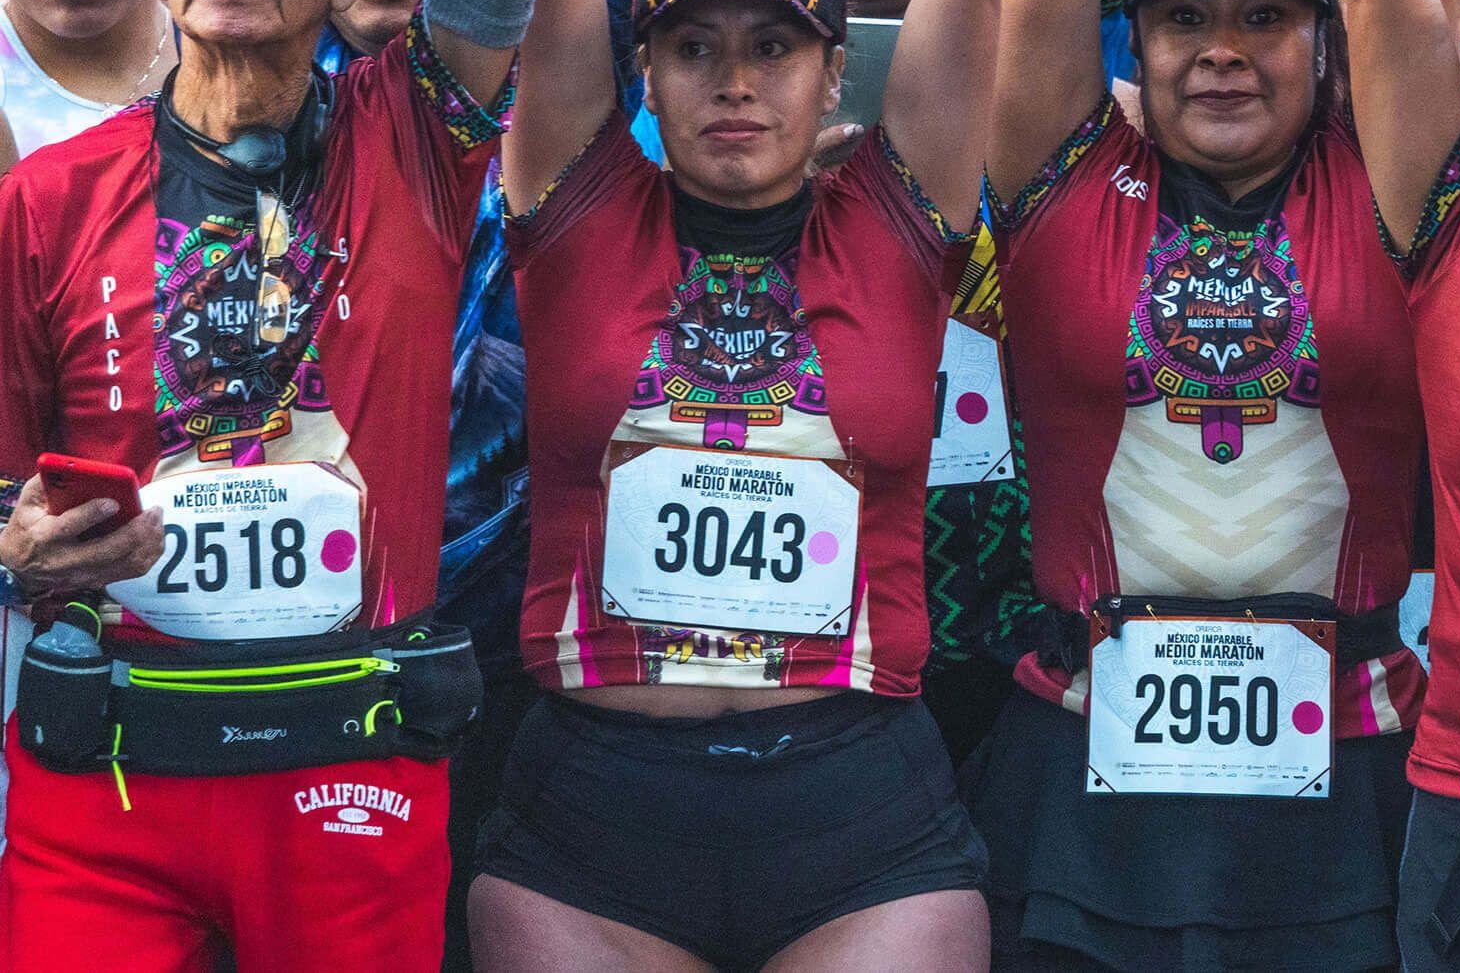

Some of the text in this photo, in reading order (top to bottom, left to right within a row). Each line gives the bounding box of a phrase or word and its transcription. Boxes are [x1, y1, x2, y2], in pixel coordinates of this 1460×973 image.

[1187, 275, 1255, 302] MÉXICO
[101, 276, 124, 412] PACO
[680, 473, 795, 497] MEDIO MARATÓN
[695, 464, 783, 482] MÉXICO IMPARABLE
[185, 478, 274, 494] MÉXICO IMPARABLE
[173, 492, 217, 509] MEDIO
[654, 502, 807, 583] 3043
[157, 517, 307, 594] 2518
[1166, 631, 1253, 646] MÉXICO IMPARABLE
[1154, 642, 1265, 661] MEDIO MARATÓN
[1134, 674, 1279, 747] 2950
[293, 783, 413, 822] CALIFORNIA
